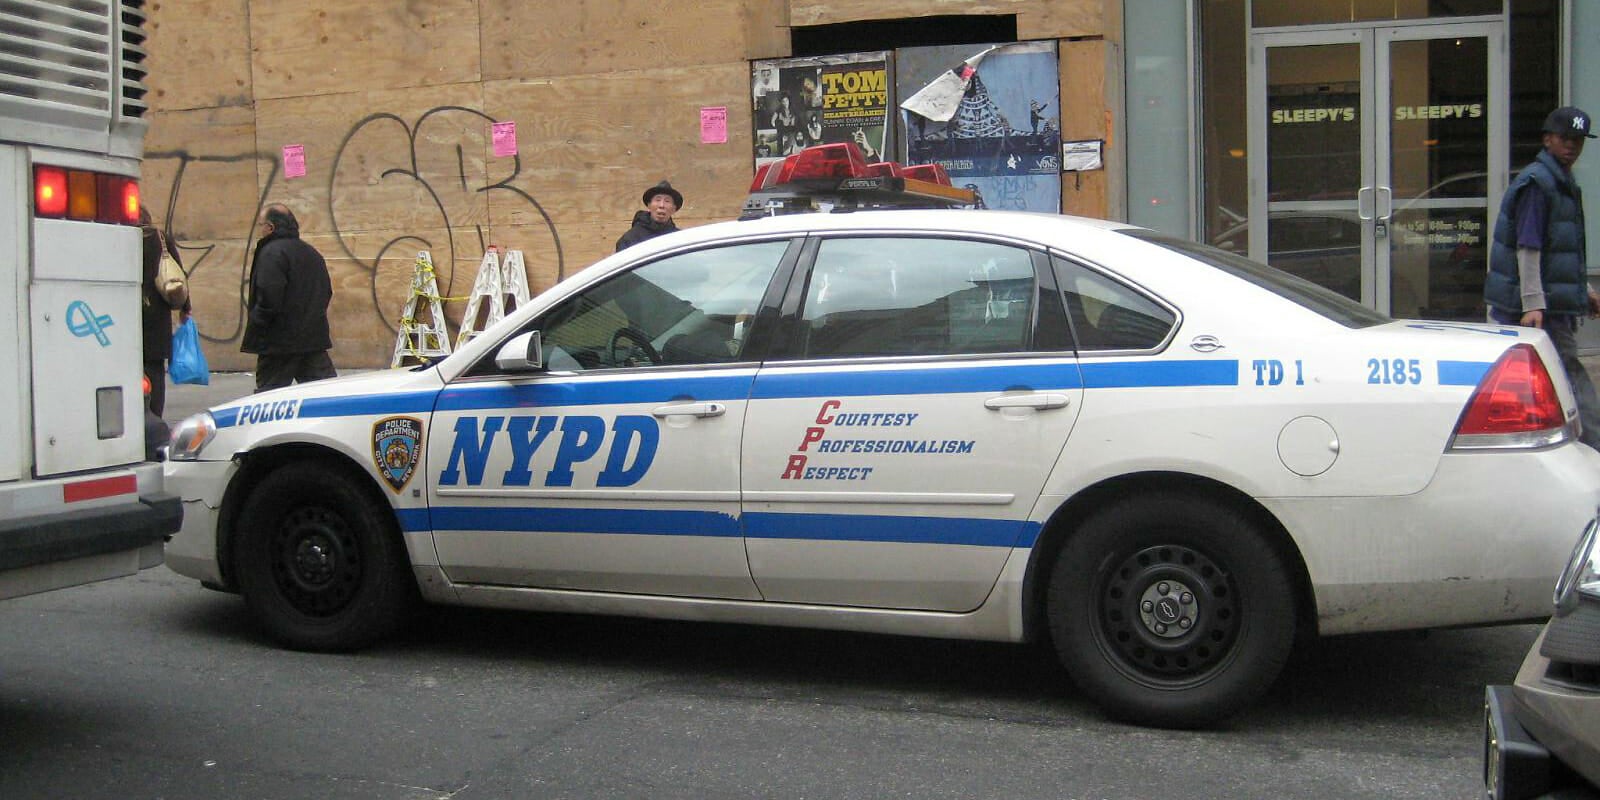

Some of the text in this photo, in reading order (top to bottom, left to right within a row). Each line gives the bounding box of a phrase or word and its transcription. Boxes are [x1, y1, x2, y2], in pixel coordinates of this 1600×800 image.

[822, 71, 886, 94] TOM
[823, 91, 886, 108] PETTY
[1272, 107, 1355, 124] SLEEPY'S
[1395, 104, 1481, 121] SLEEPY'S
[1252, 359, 1304, 386] TD 1
[1367, 358, 1422, 385] 2185
[238, 399, 299, 426] POLICE
[375, 427, 420, 441] DEPARTMENT
[385, 420, 411, 429] POLICE
[438, 415, 660, 487] NYPD
